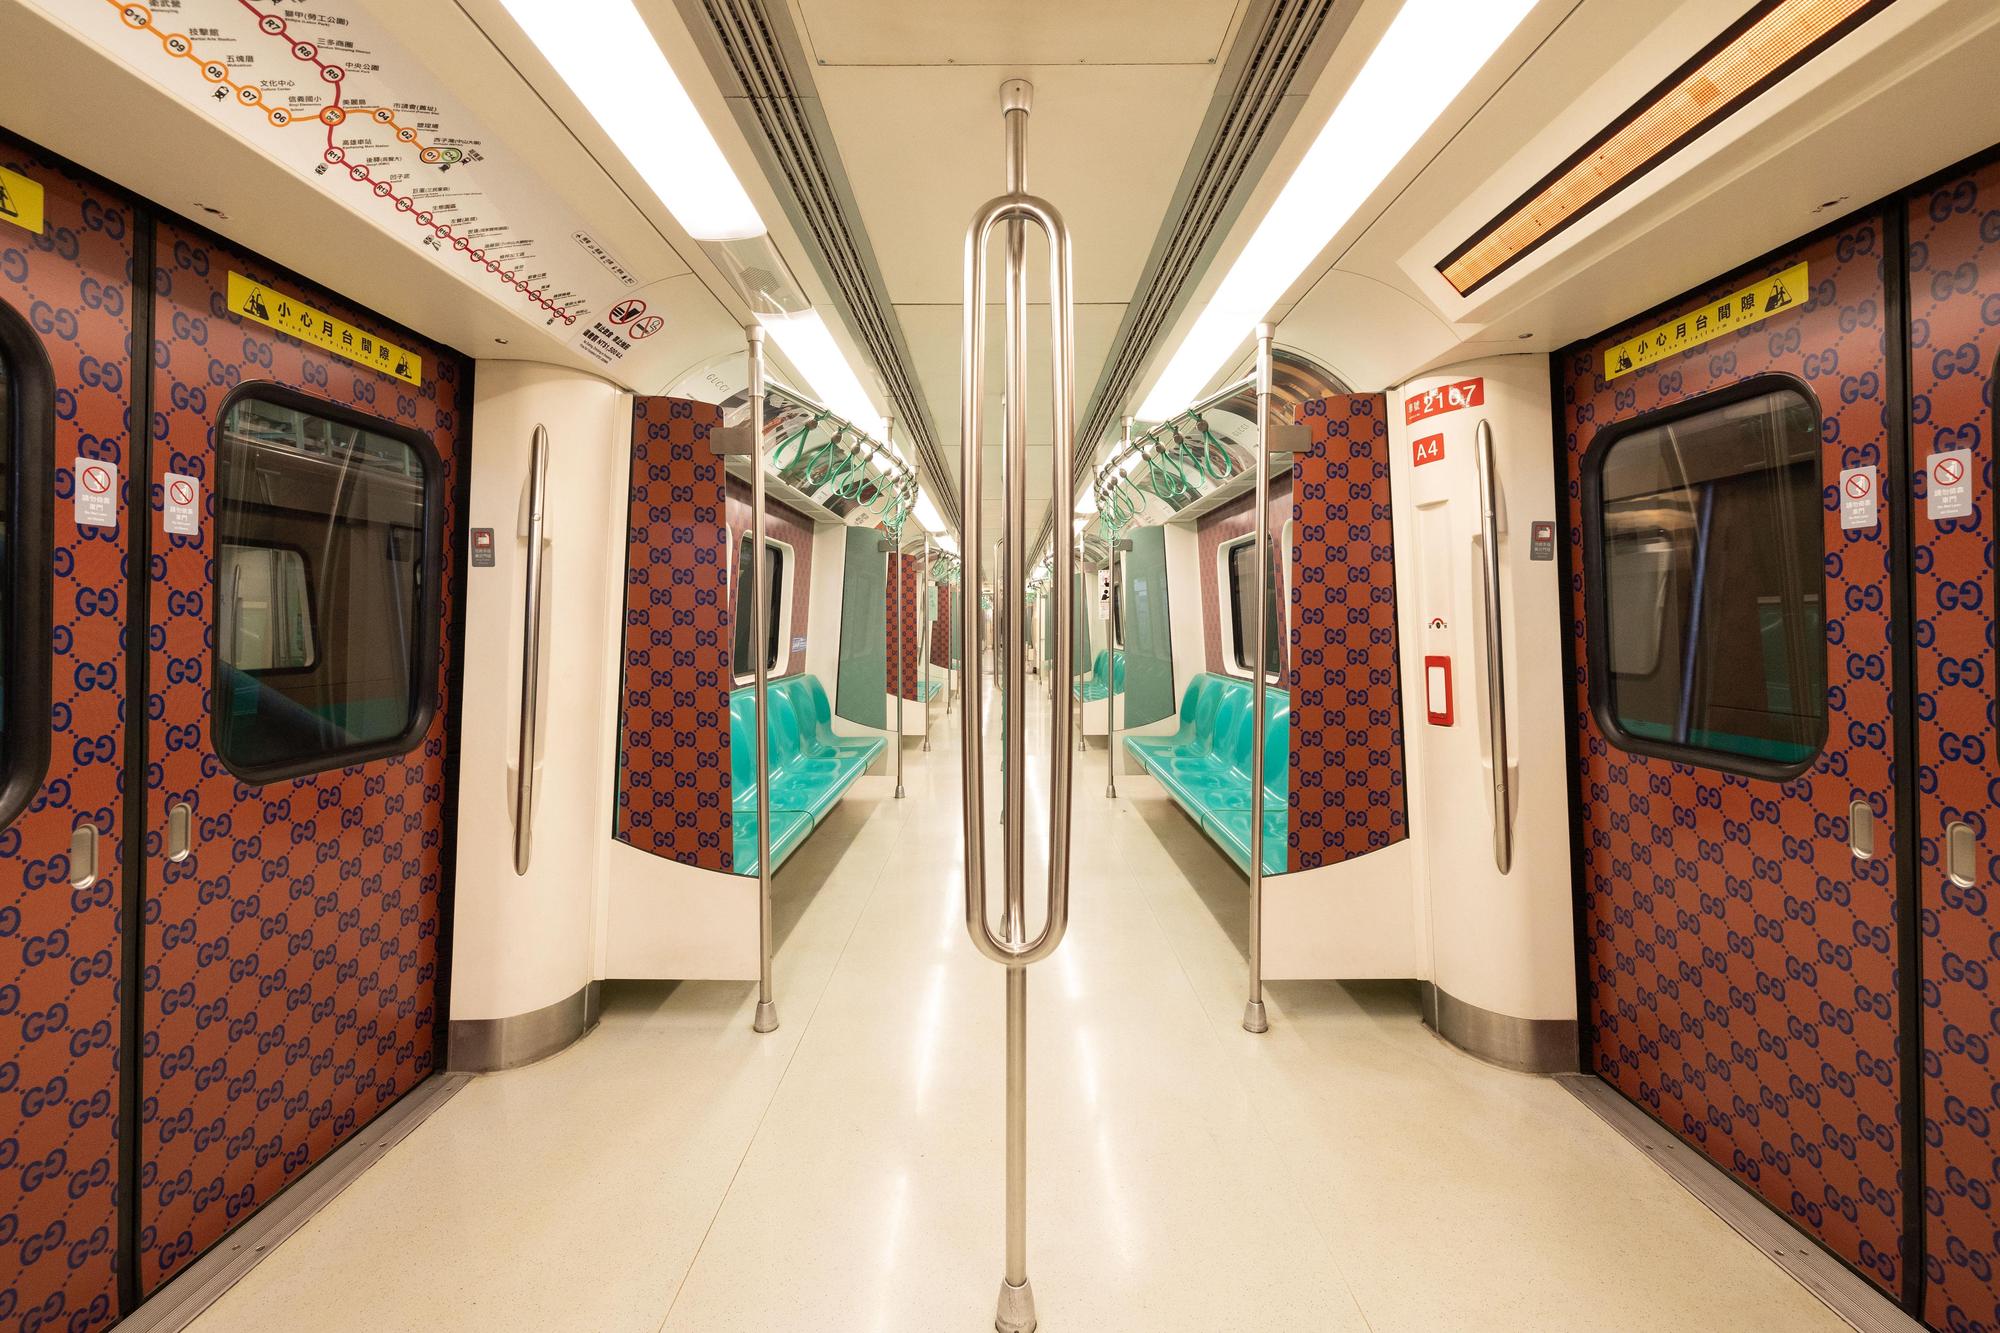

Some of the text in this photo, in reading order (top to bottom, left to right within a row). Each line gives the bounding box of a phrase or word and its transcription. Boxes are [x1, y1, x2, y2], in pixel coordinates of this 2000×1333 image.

[124, 8, 147, 26] O10
[265, 19, 281, 31] R7
[169, 39, 186, 52] O9
[297, 45, 312, 57] R8
[345, 62, 380, 71] 中央公園
[207, 66, 223, 79] O8
[326, 69, 340, 80] R9
[242, 90, 257, 101] O7
[273, 112, 287, 123] O6
[377, 111, 390, 121] O4
[401, 130, 412, 140] O2
[327, 150, 340, 161] R11
[427, 151, 437, 159] O1
[353, 168, 366, 178] R12
[376, 184, 388, 194] R13
[398, 200, 410, 209] R14
[1637, 292, 1756, 356] 小心月台間隙
[278, 302, 390, 361] 小心月台間隙
[1683, 323, 1728, 345] Platform
[278, 319, 302, 333] Mind
[329, 340, 369, 360] Platform
[706, 373, 731, 393] GUCCI
[1417, 440, 1438, 461] A4
